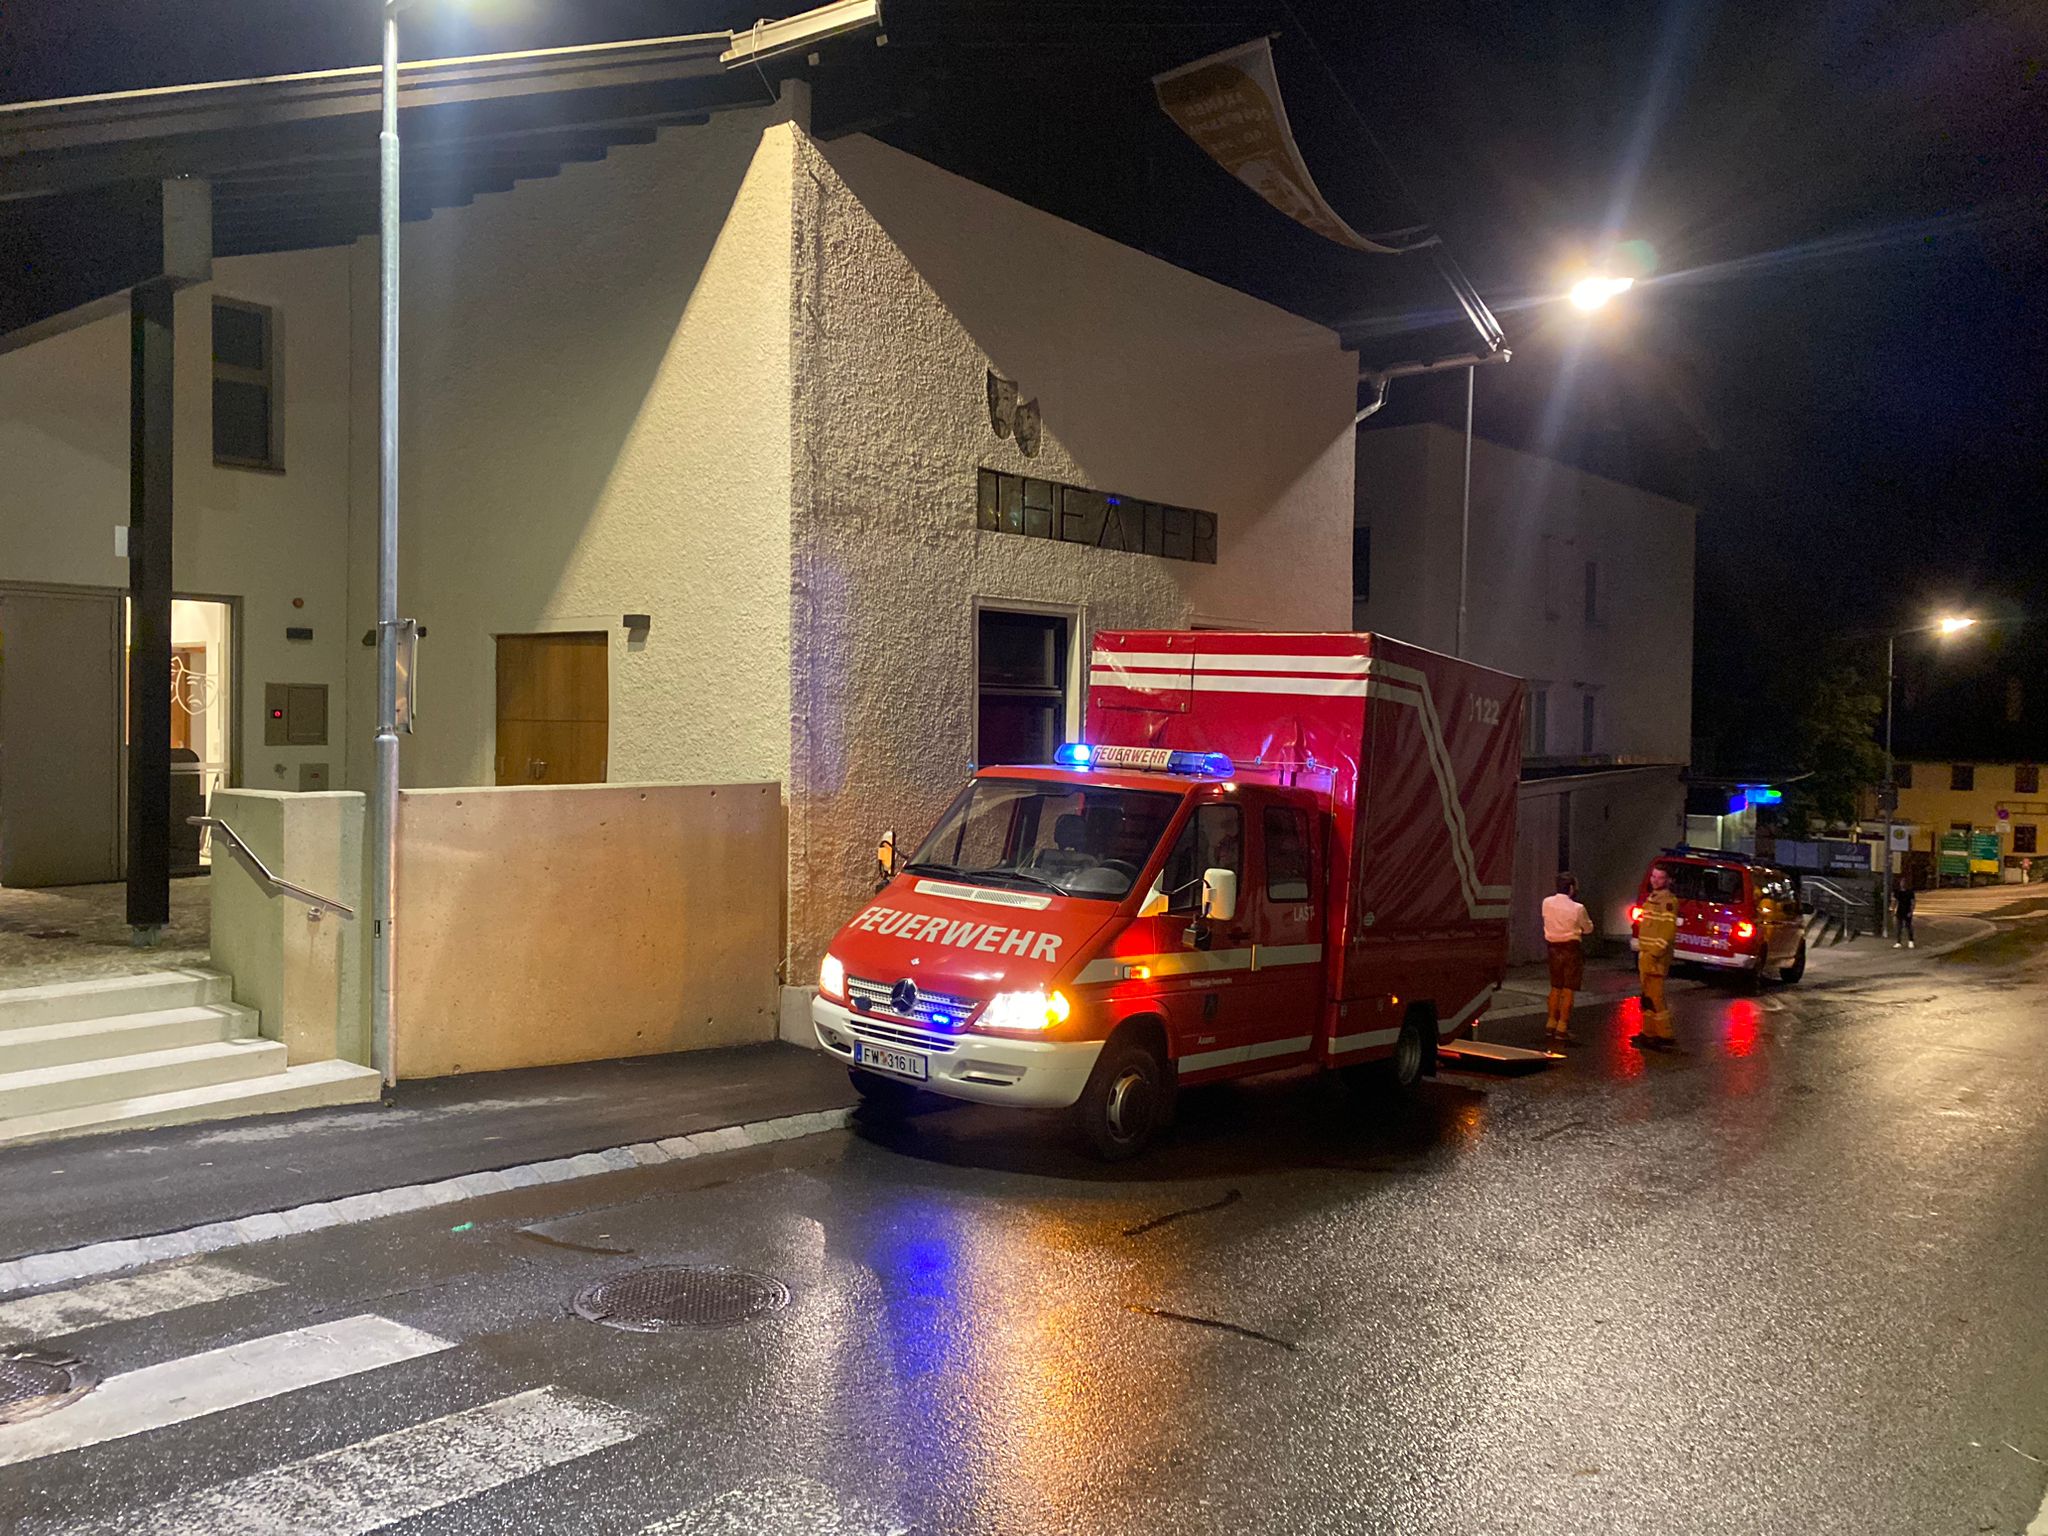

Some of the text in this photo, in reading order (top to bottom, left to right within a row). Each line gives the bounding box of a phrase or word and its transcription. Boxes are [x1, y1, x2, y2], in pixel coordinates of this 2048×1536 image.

[979, 467, 1217, 563] THEATER
[1474, 696, 1499, 725] 122
[1093, 746, 1168, 765] FEUERWEHR
[848, 906, 1063, 963] FEUERWEHR
[1675, 932, 1729, 950] ERWEHR
[863, 1048, 920, 1074] FW 316 IL
